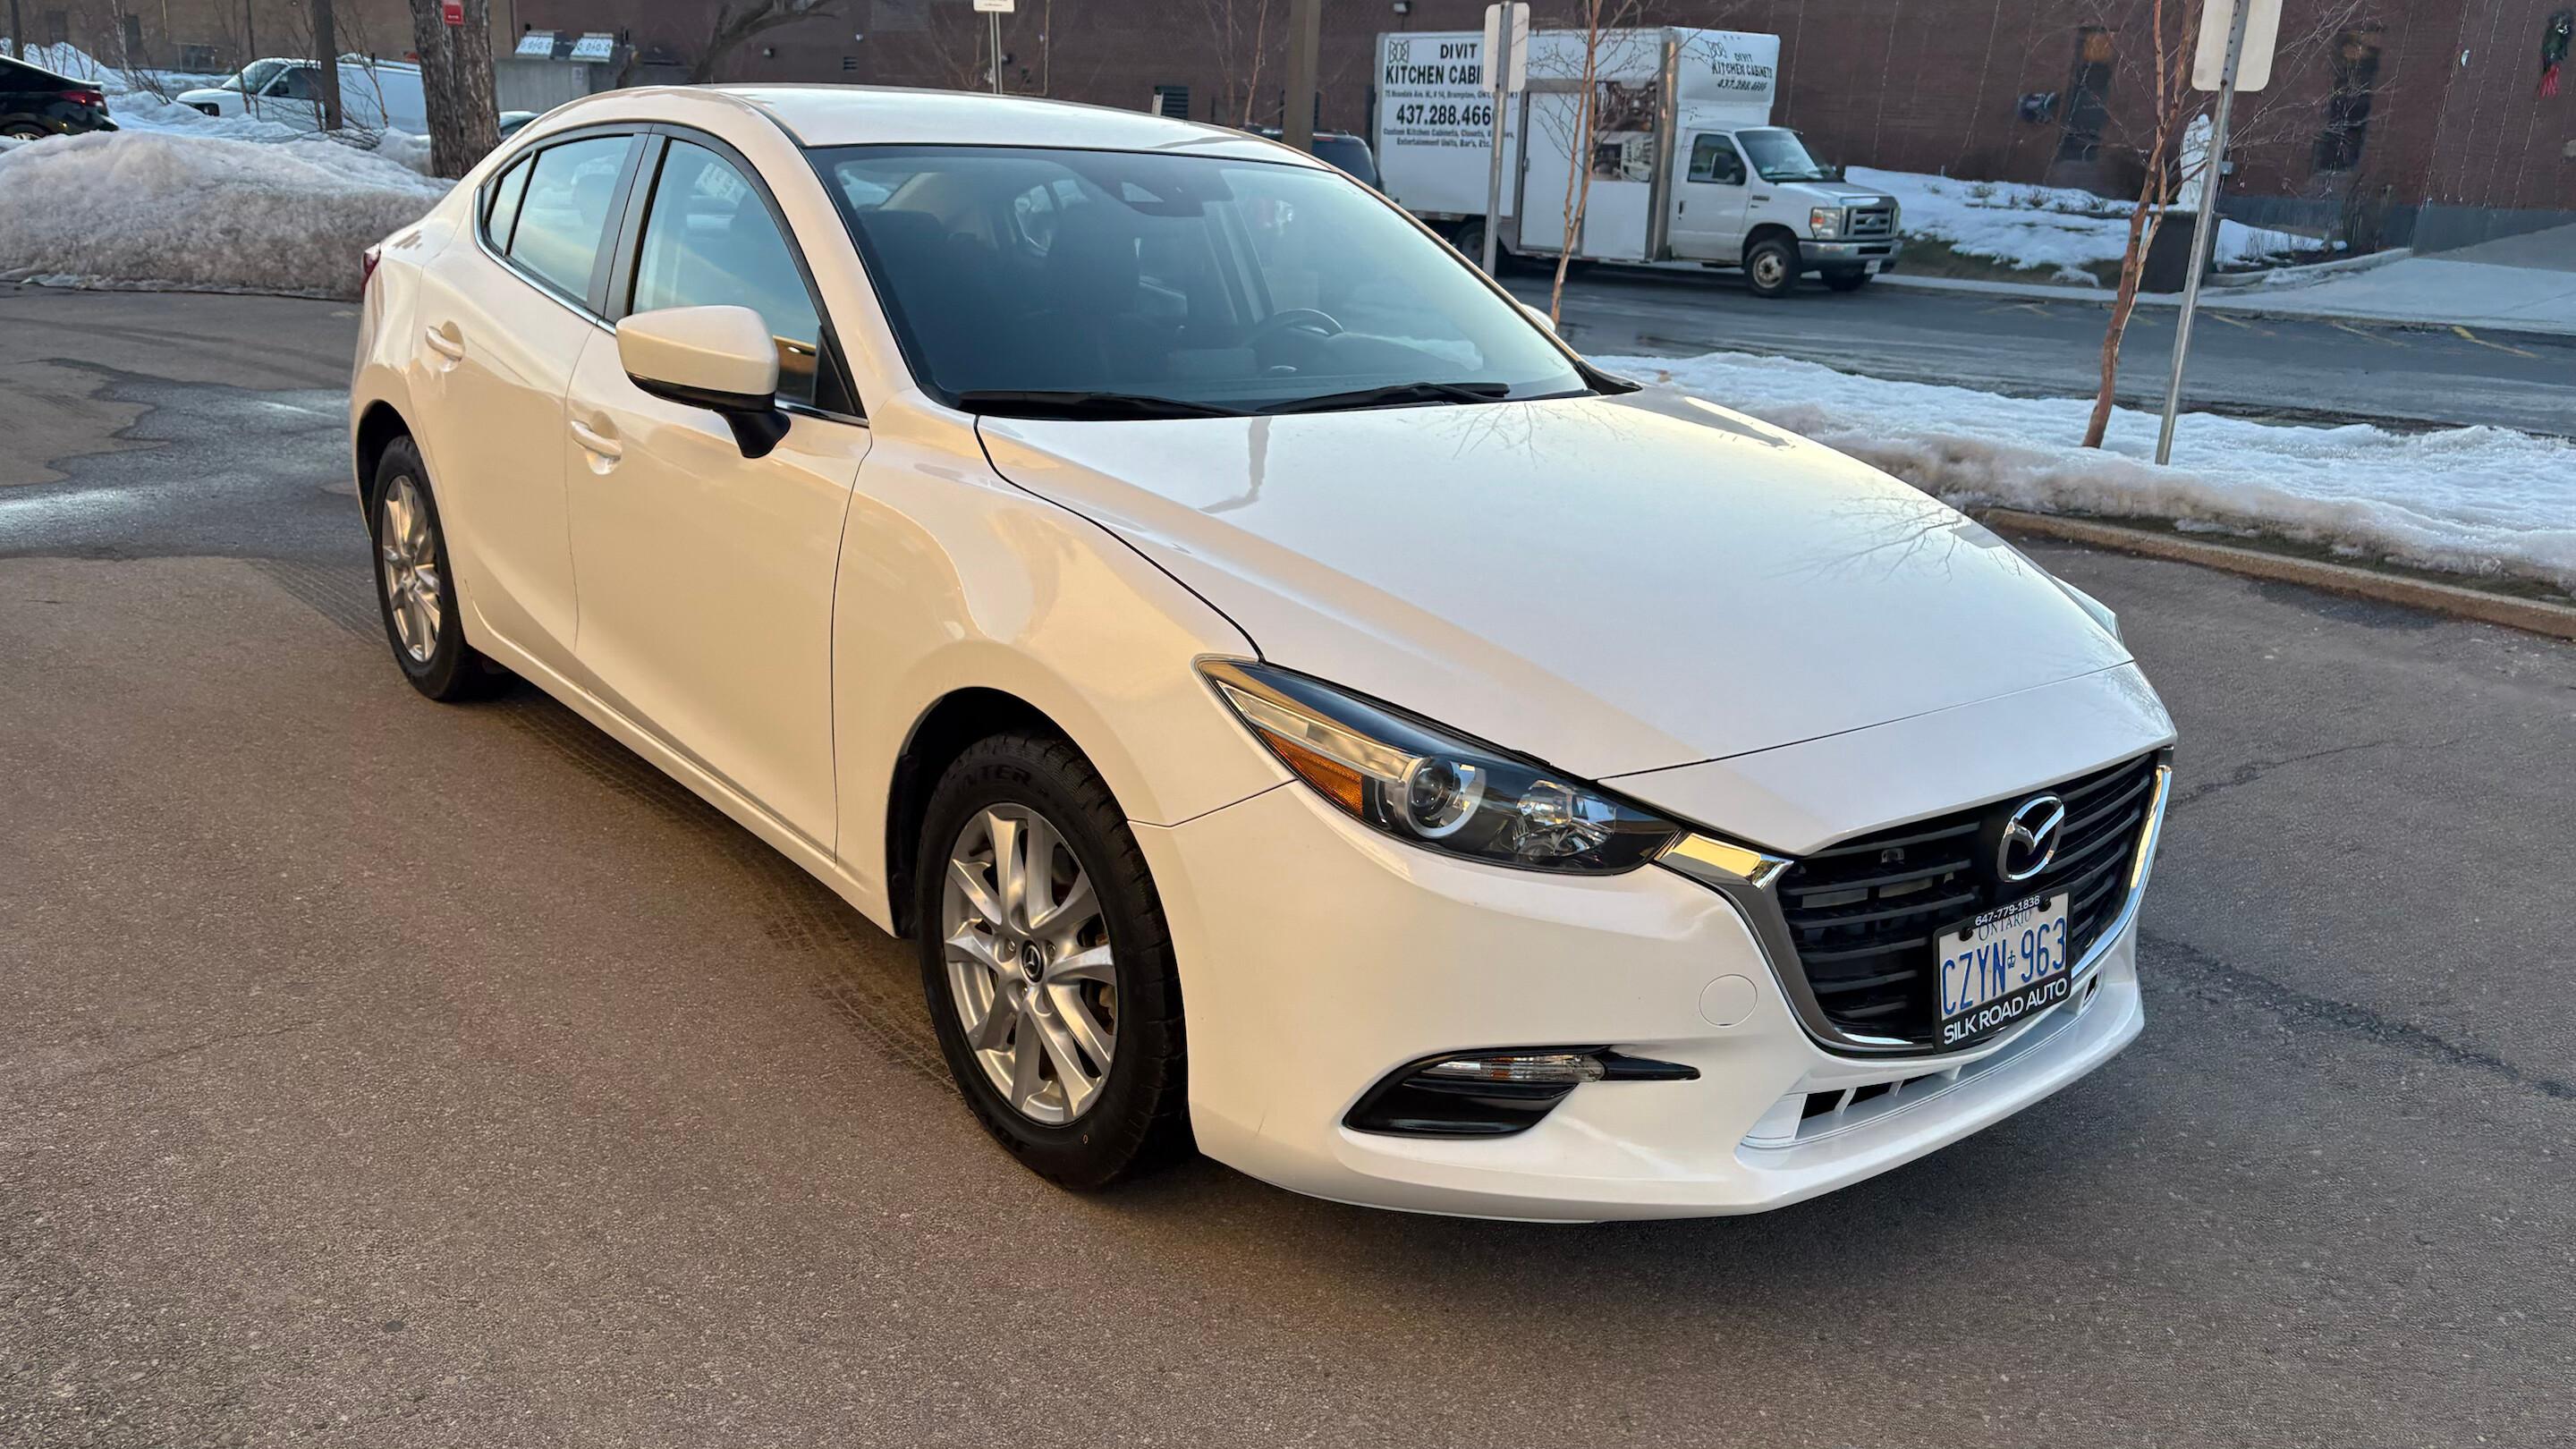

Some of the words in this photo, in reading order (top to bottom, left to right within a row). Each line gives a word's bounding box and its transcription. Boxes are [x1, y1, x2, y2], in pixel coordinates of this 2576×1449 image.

[1440, 43, 1478, 59] DIVIT
[1385, 64, 1445, 84] KITCHEN
[1448, 65, 1484, 84] CABI
[1712, 61, 1745, 75] KITCHEN
[1396, 104, 1496, 126] 437.288.466
[1975, 895, 2040, 927] 647-779-1838
[1978, 910, 2032, 941] ONTARIO
[1942, 939, 2006, 1015] CZYN
[2021, 917, 2066, 983] 963
[1944, 1013, 1977, 1045] SILK
[1979, 999, 2024, 1030] ROAD
[2025, 978, 2068, 1010] AUTO
